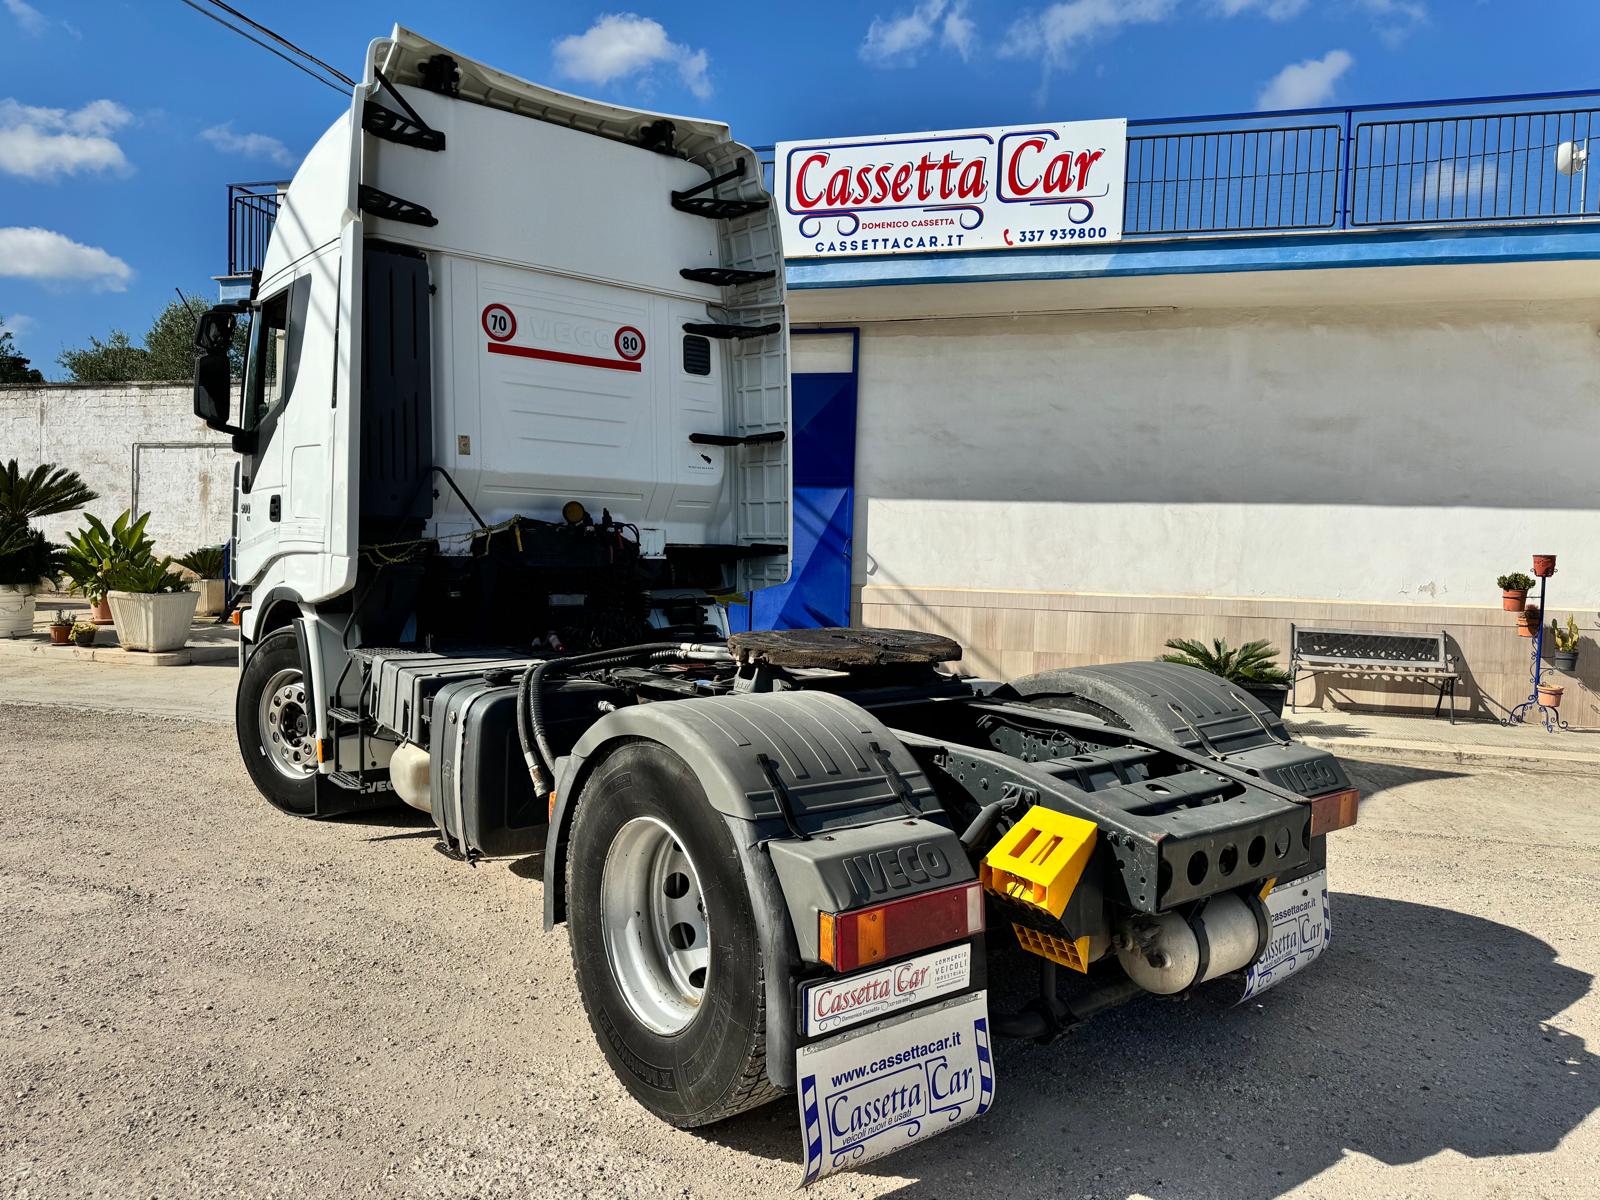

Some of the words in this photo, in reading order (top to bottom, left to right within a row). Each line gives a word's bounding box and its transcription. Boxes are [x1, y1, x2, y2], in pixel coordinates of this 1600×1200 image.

[796, 151, 987, 208] Cassetta
[1008, 136, 1106, 196] Car
[861, 220, 909, 230] DOMENICO
[912, 218, 955, 229] CASSETTA
[1019, 230, 1044, 242] 337
[1050, 227, 1108, 241] 939800
[815, 234, 965, 253] CASSETTACAR.IT
[491, 314, 507, 332] 70
[622, 336, 638, 351] 80
[360, 780, 394, 795] VEC
[1276, 760, 1338, 793] IVECO
[842, 842, 952, 899] IVECO
[1260, 932, 1297, 964] assetta
[1302, 918, 1322, 944] Car
[935, 951, 967, 966] COMMERCIO
[935, 958, 967, 975] VEICOLI
[817, 980, 890, 1017] Cassetta
[897, 965, 930, 993] Car
[831, 1031, 962, 1087] www.cassettacar.it
[830, 1082, 922, 1137] Cassetta
[931, 1062, 973, 1100] Car
[842, 1127, 867, 1146] veicoli
[867, 1119, 887, 1136] nuovi
[888, 1117, 893, 1125] e
[894, 1108, 912, 1122] usati
